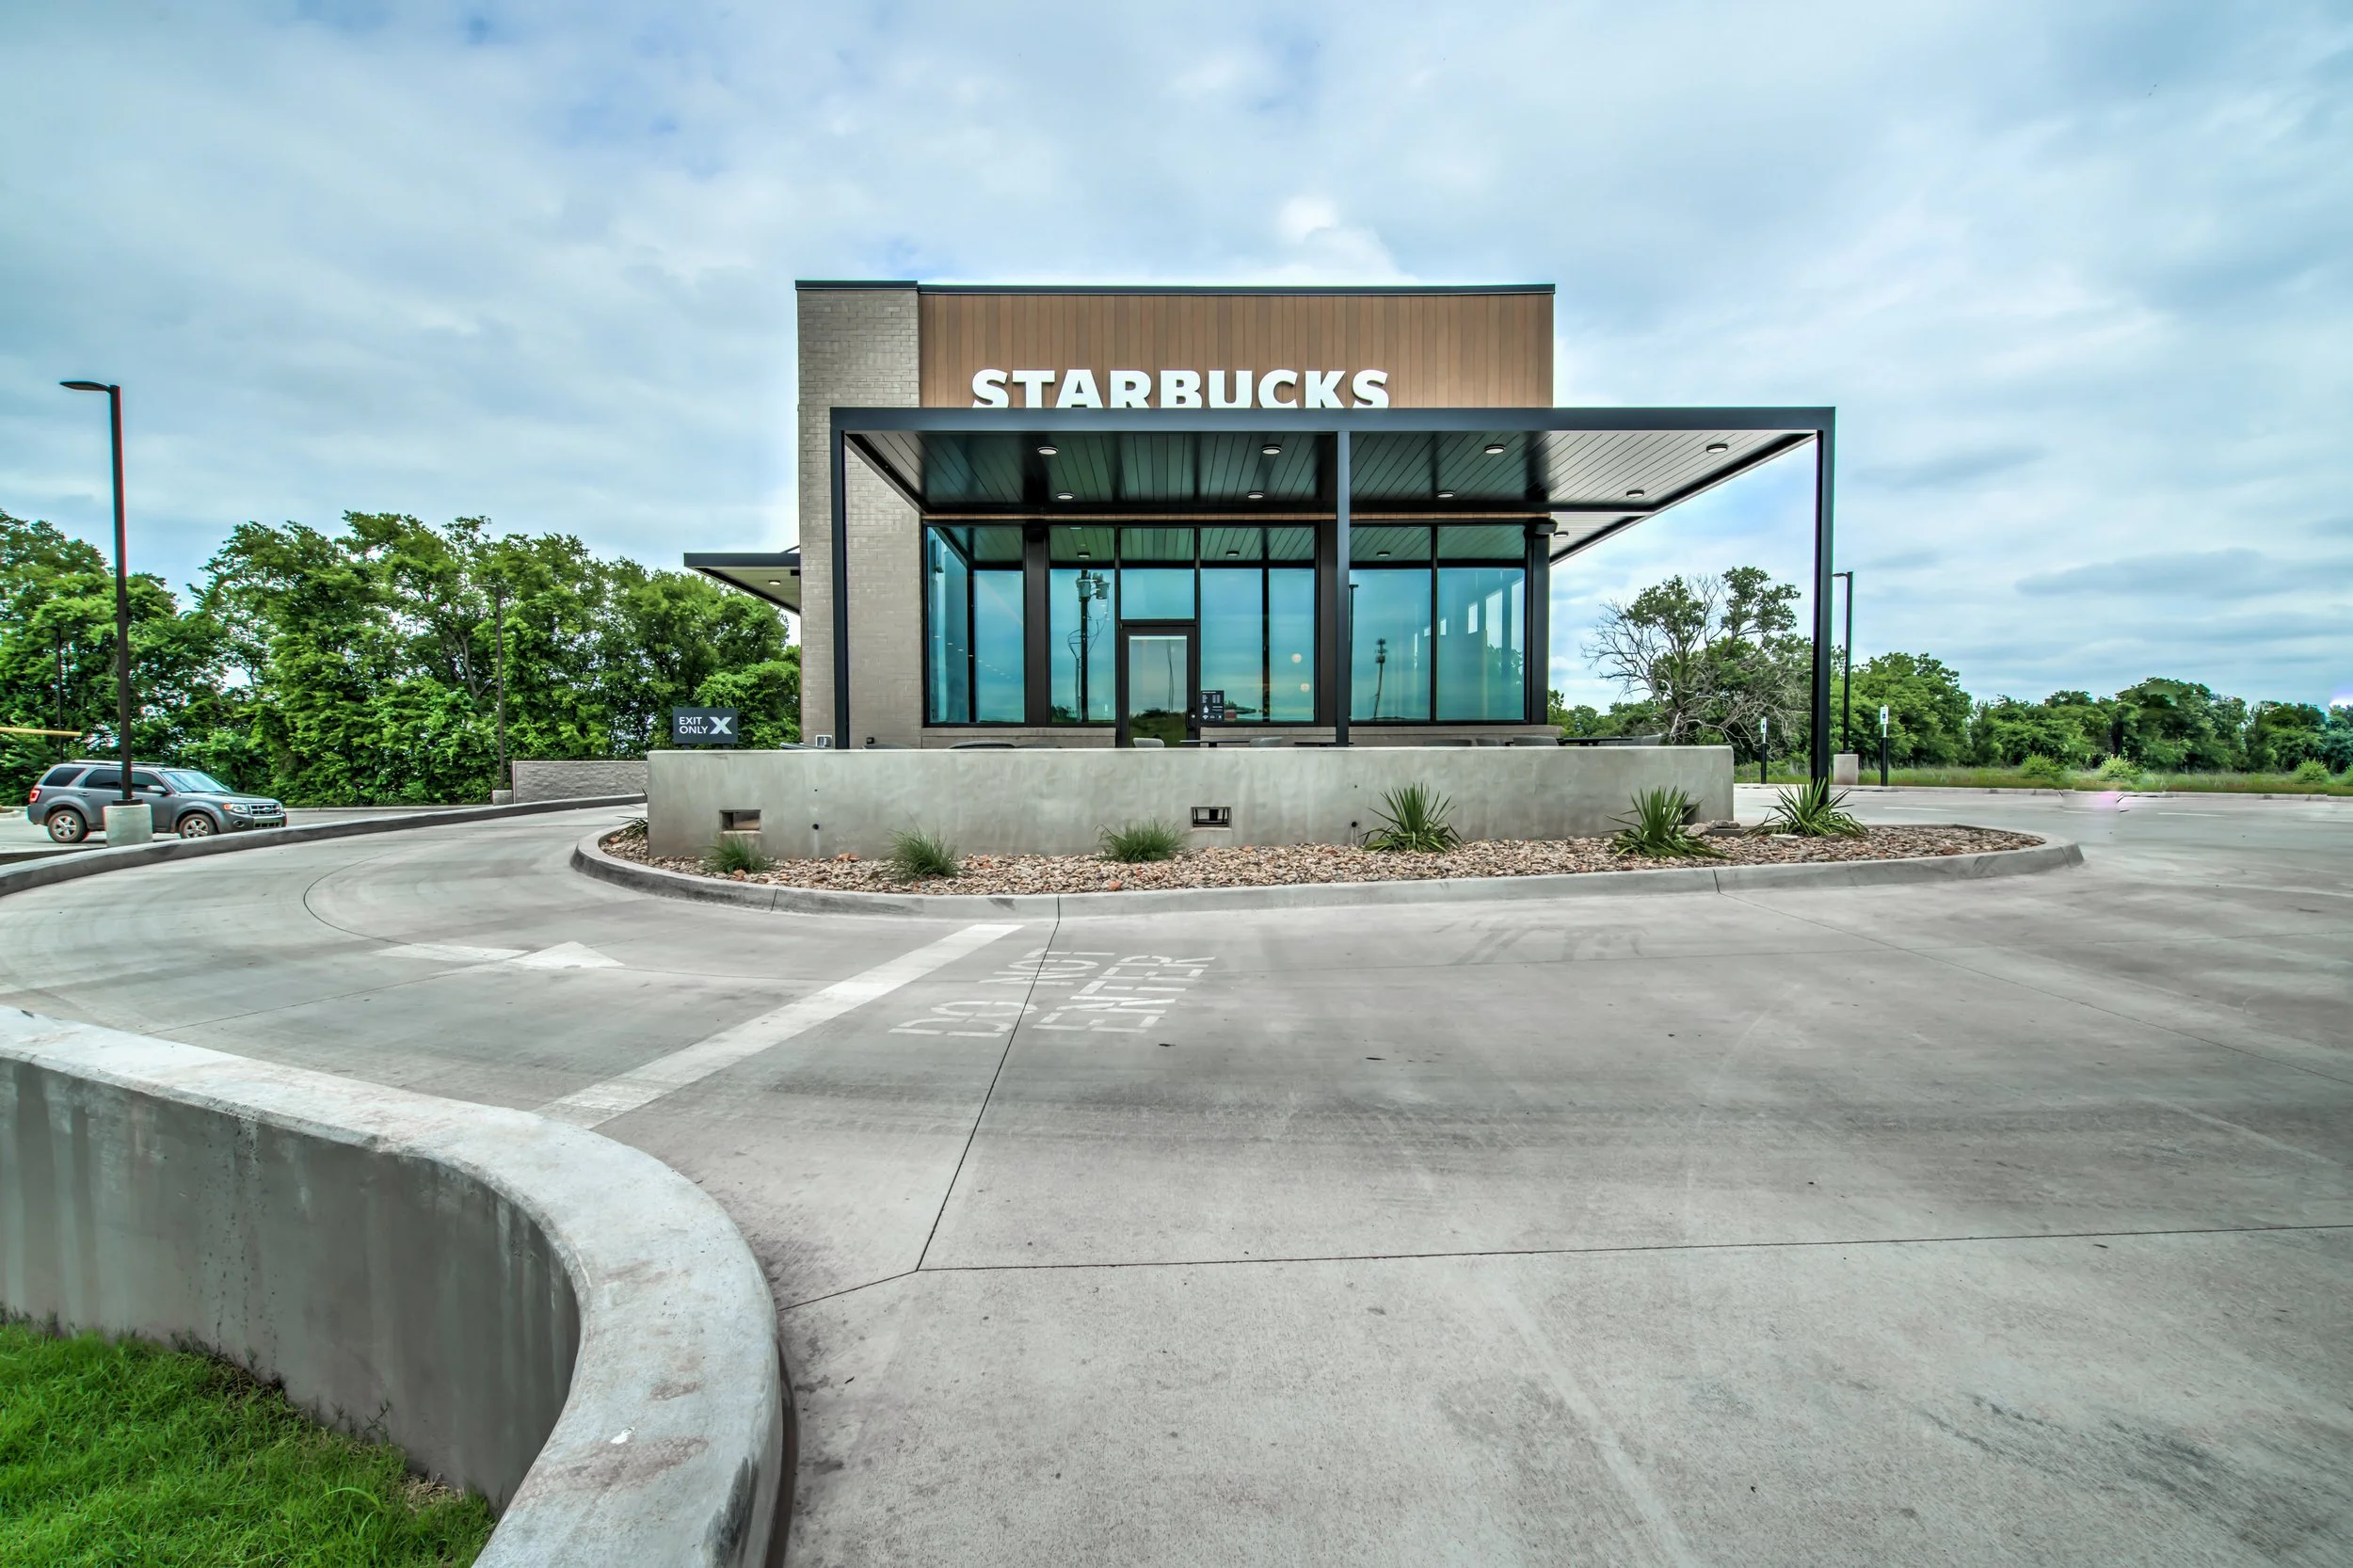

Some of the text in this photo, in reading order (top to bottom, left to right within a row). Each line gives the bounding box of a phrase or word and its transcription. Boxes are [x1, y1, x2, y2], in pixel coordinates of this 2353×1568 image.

[971, 369, 1390, 408] STARBUCKS
[679, 716, 703, 725] EXIT
[679, 726, 708, 734] ONLY
[888, 948, 1115, 1037] DO NOT
[1032, 954, 1216, 1033] ENTER
